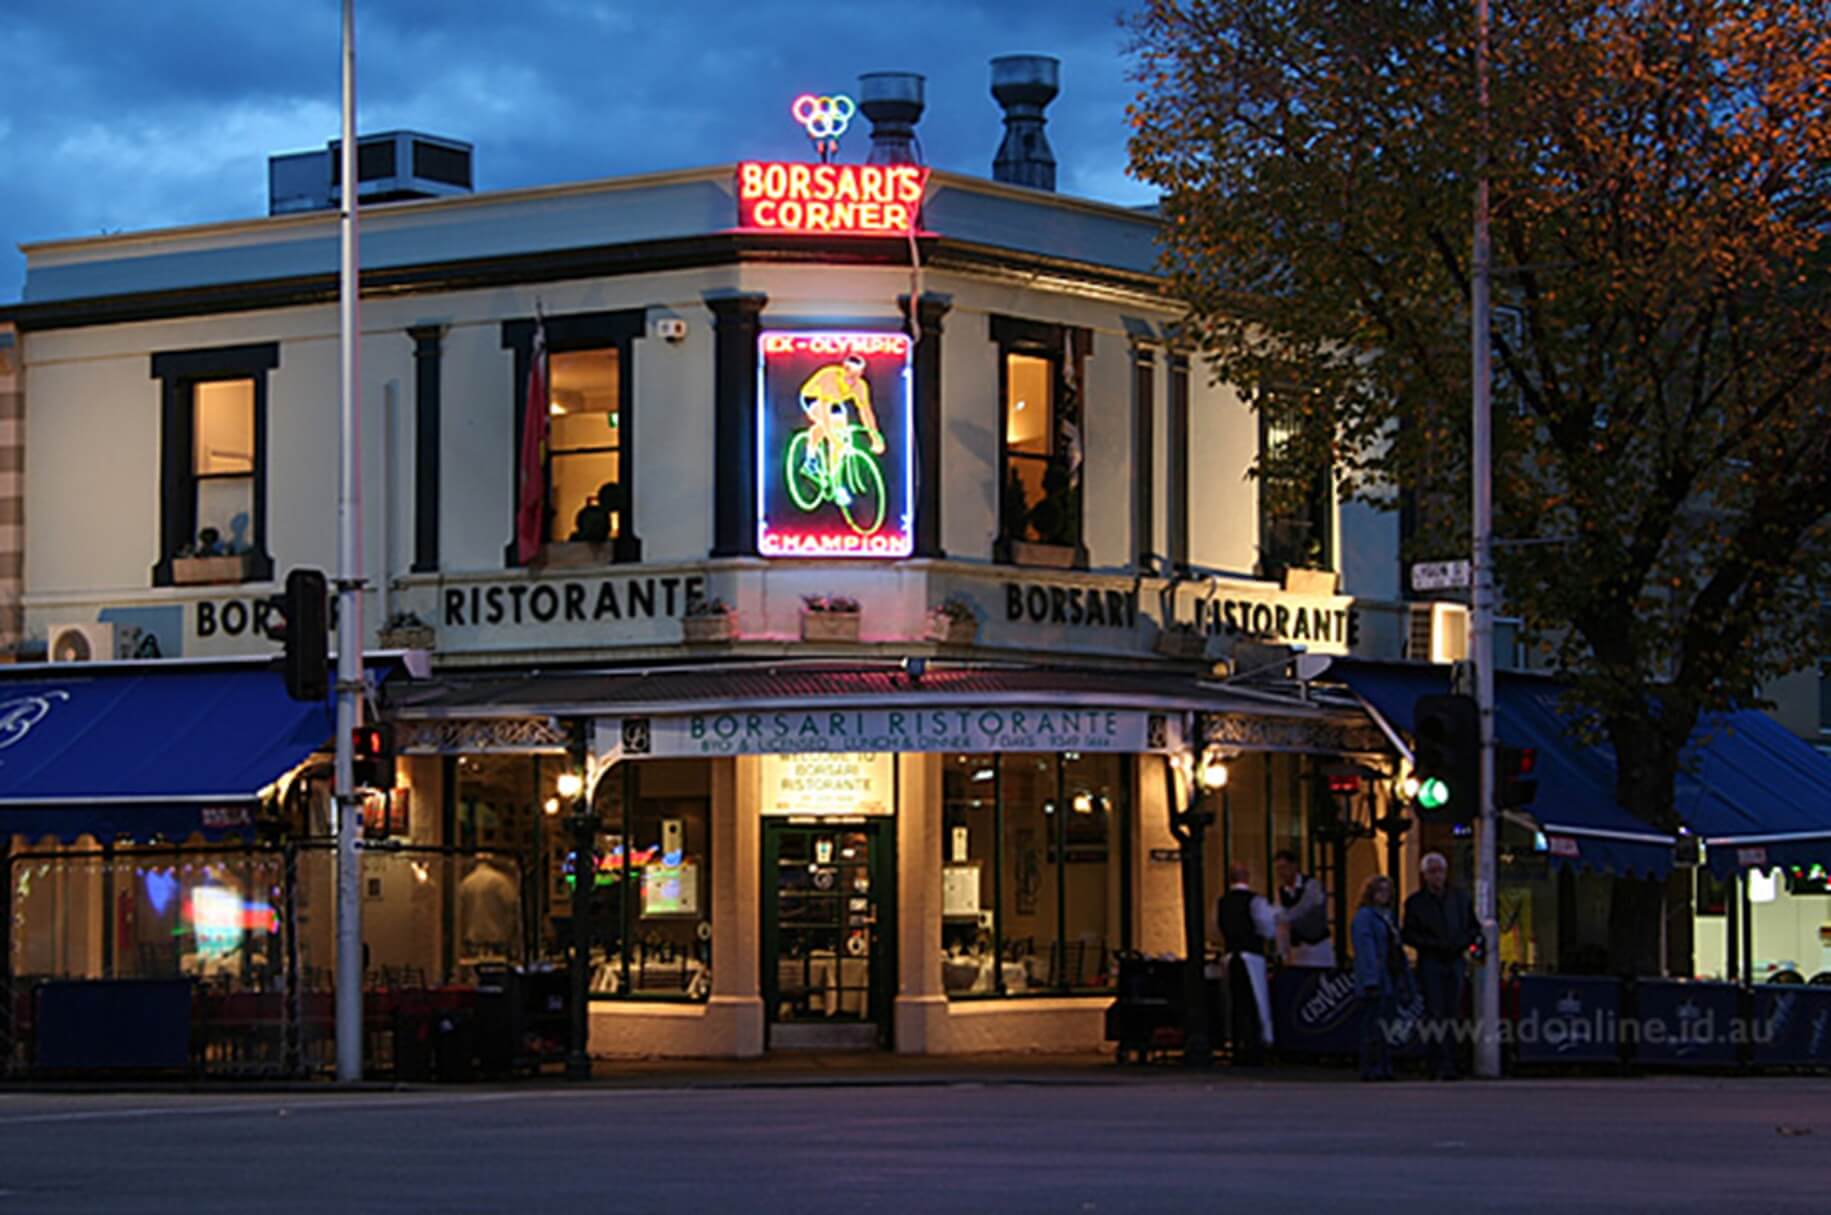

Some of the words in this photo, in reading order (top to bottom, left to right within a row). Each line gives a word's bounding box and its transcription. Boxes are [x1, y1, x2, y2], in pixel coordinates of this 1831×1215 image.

[741, 163, 922, 202] BORSARI'S
[753, 200, 910, 231] CORNER
[765, 336, 906, 354] EX-OLYMPIC
[766, 533, 906, 552] CHAMPION
[444, 575, 705, 626] RISTORANTE
[1005, 583, 1137, 629] BORSARI
[1195, 596, 1359, 648] RISTORANTE
[690, 711, 864, 739] BORSARI
[889, 709, 1118, 735] RISTORANTE
[781, 778, 872, 791] RISTORANTE
